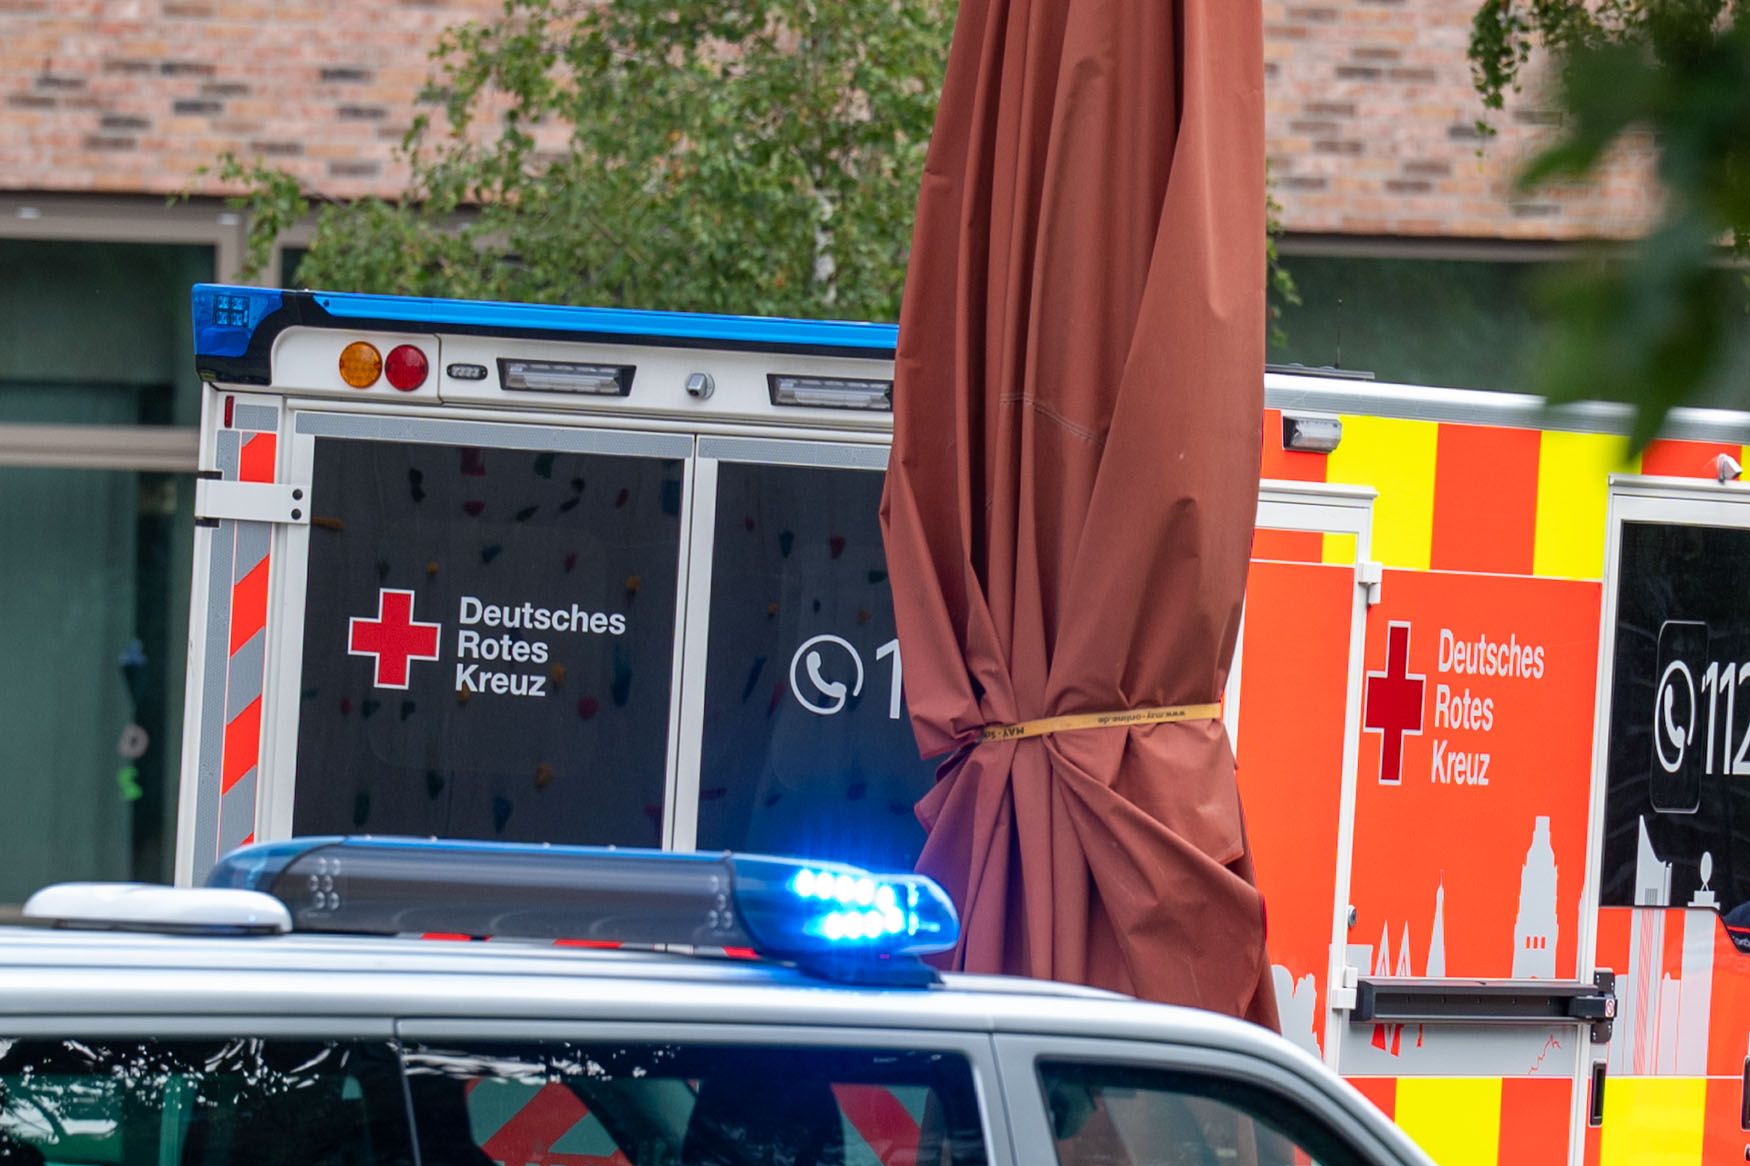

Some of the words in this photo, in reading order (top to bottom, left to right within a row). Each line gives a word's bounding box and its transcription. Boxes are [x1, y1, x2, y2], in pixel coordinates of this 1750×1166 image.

[459, 596, 626, 635] Deutsches
[457, 629, 549, 664] Rotes
[1438, 628, 1545, 679] Deutsches
[455, 663, 546, 697] Kreuz
[1434, 683, 1494, 731] Rotes
[1431, 739, 1490, 786] Kreuz
